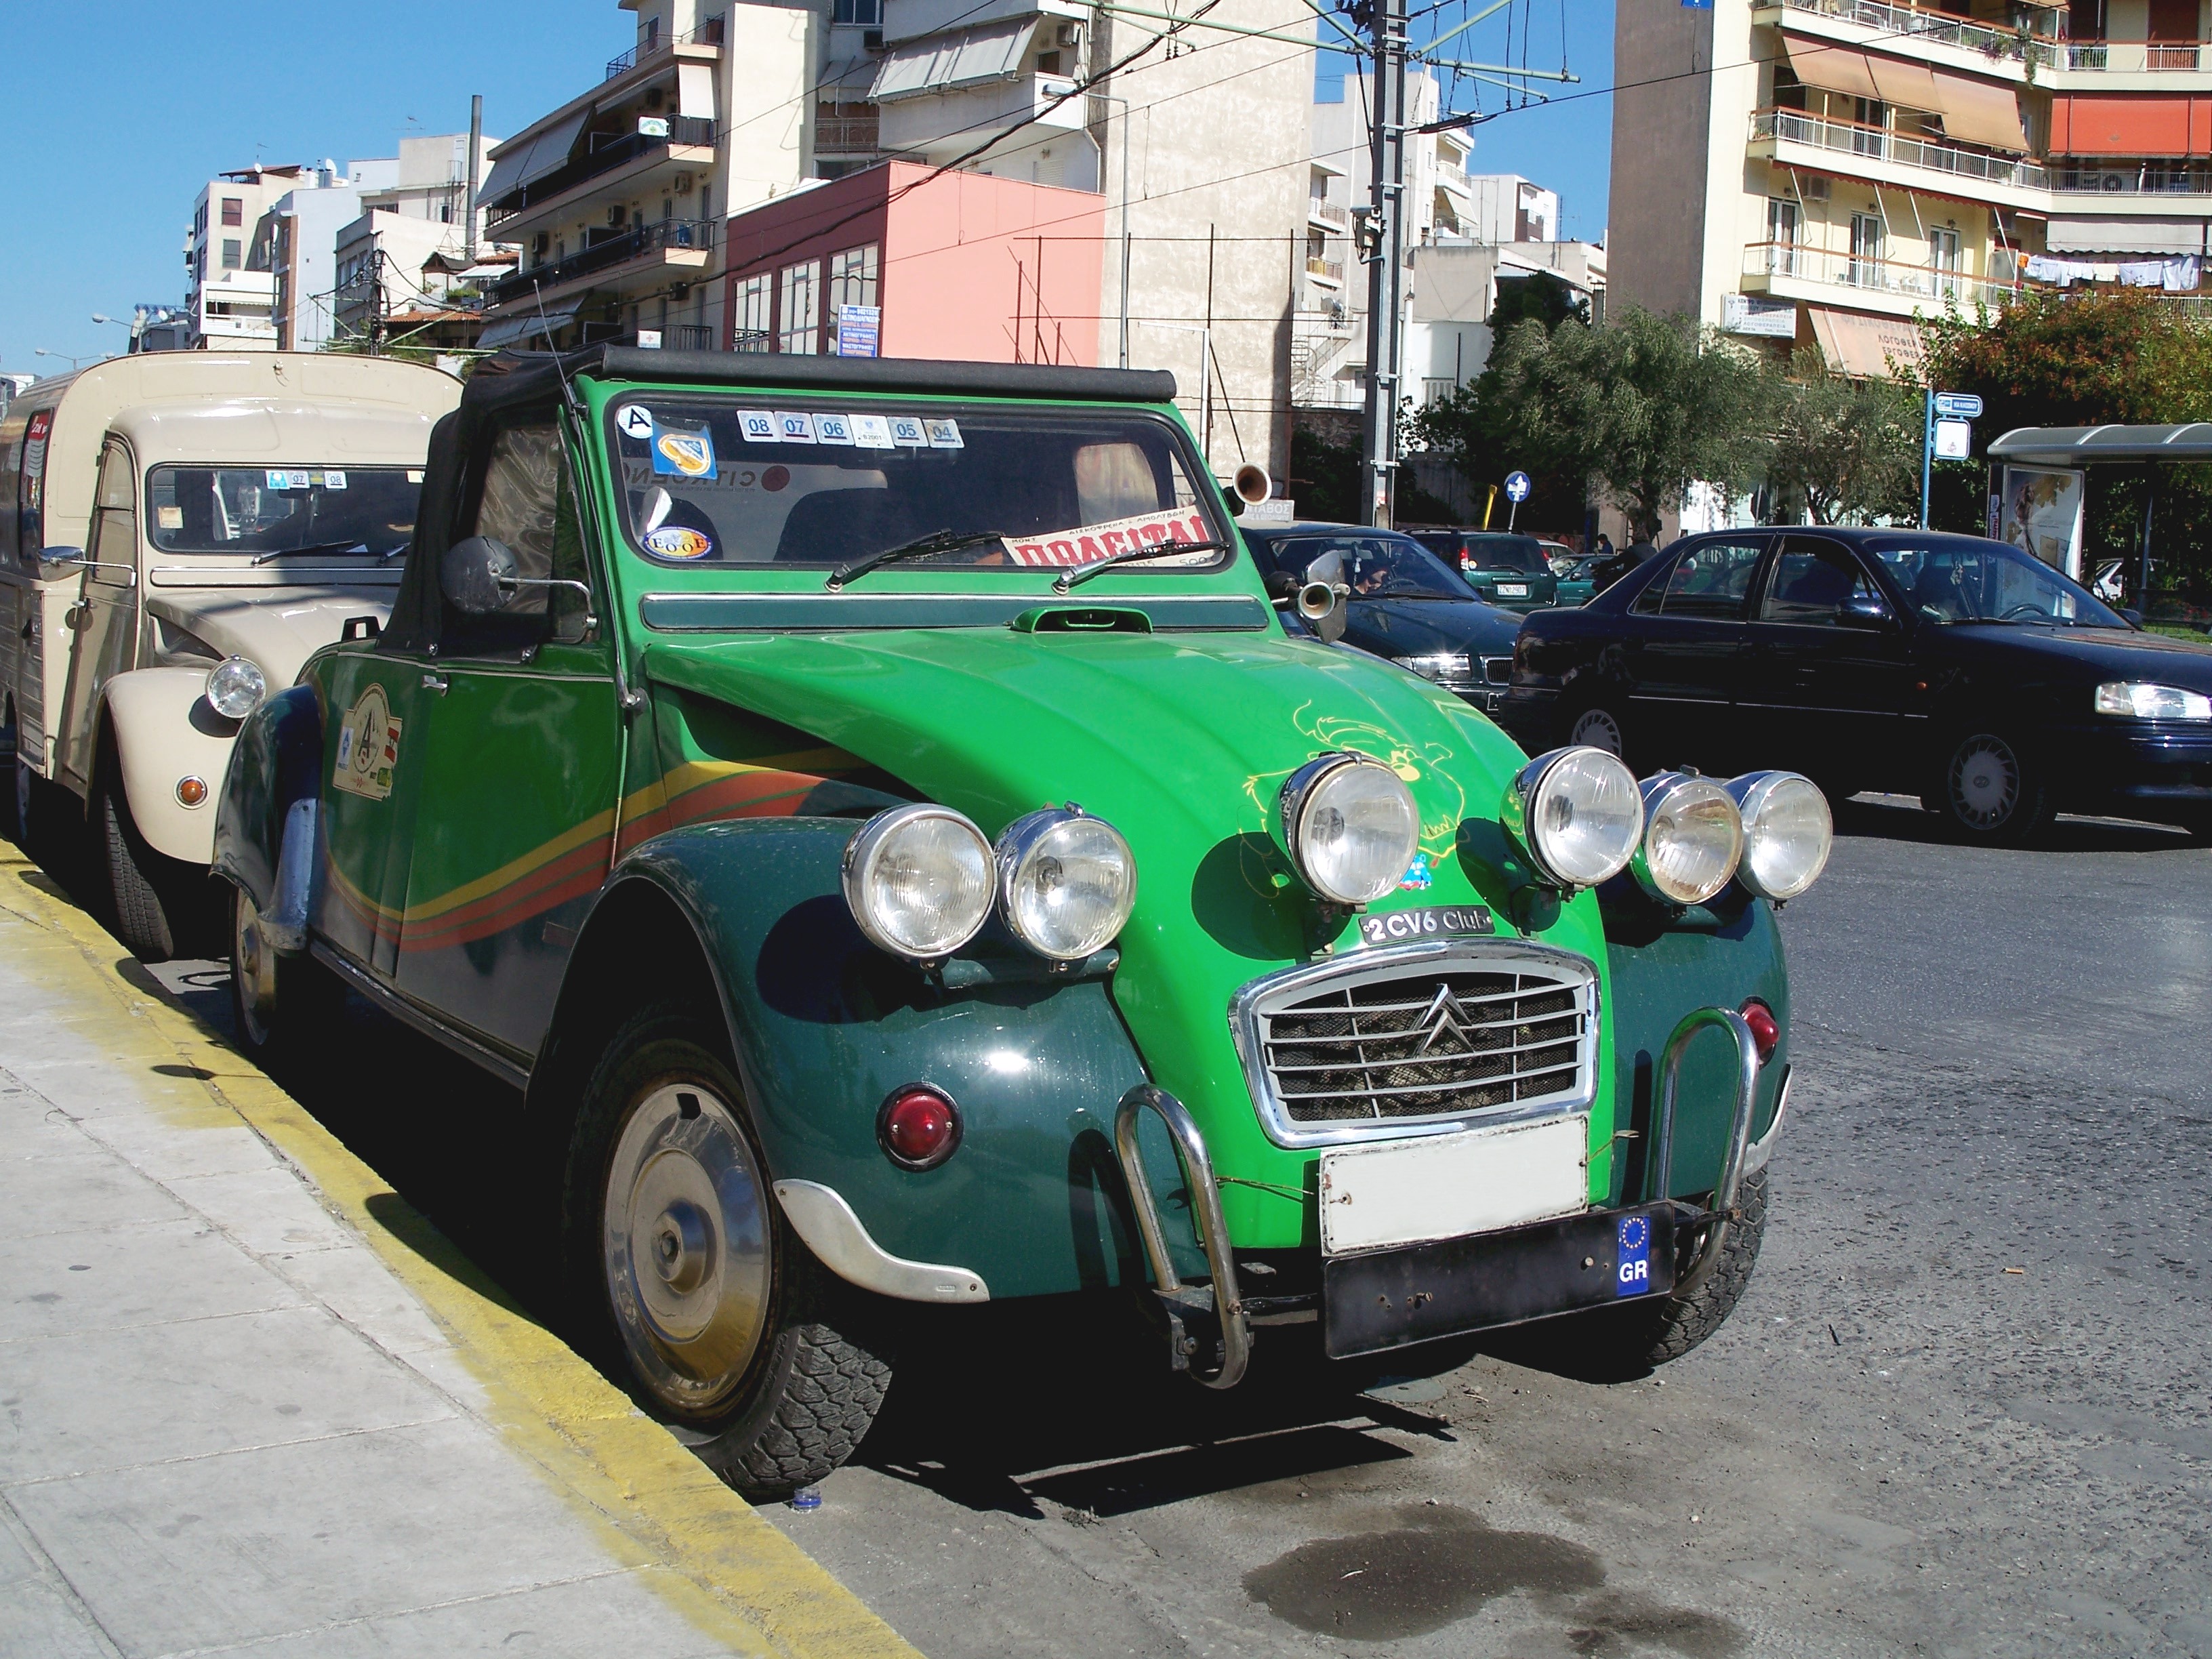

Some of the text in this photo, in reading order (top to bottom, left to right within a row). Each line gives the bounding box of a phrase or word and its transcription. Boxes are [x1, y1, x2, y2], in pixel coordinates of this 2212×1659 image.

[748, 418, 770, 433] 08
[785, 419, 805, 434] 07
[823, 421, 844, 436] 06
[896, 423, 916, 436] 05
[933, 425, 951, 438] 04
[293, 474, 304, 483] 07
[1368, 910, 1487, 941] 2CV6 Club
[1619, 1260, 1647, 1283] GR
